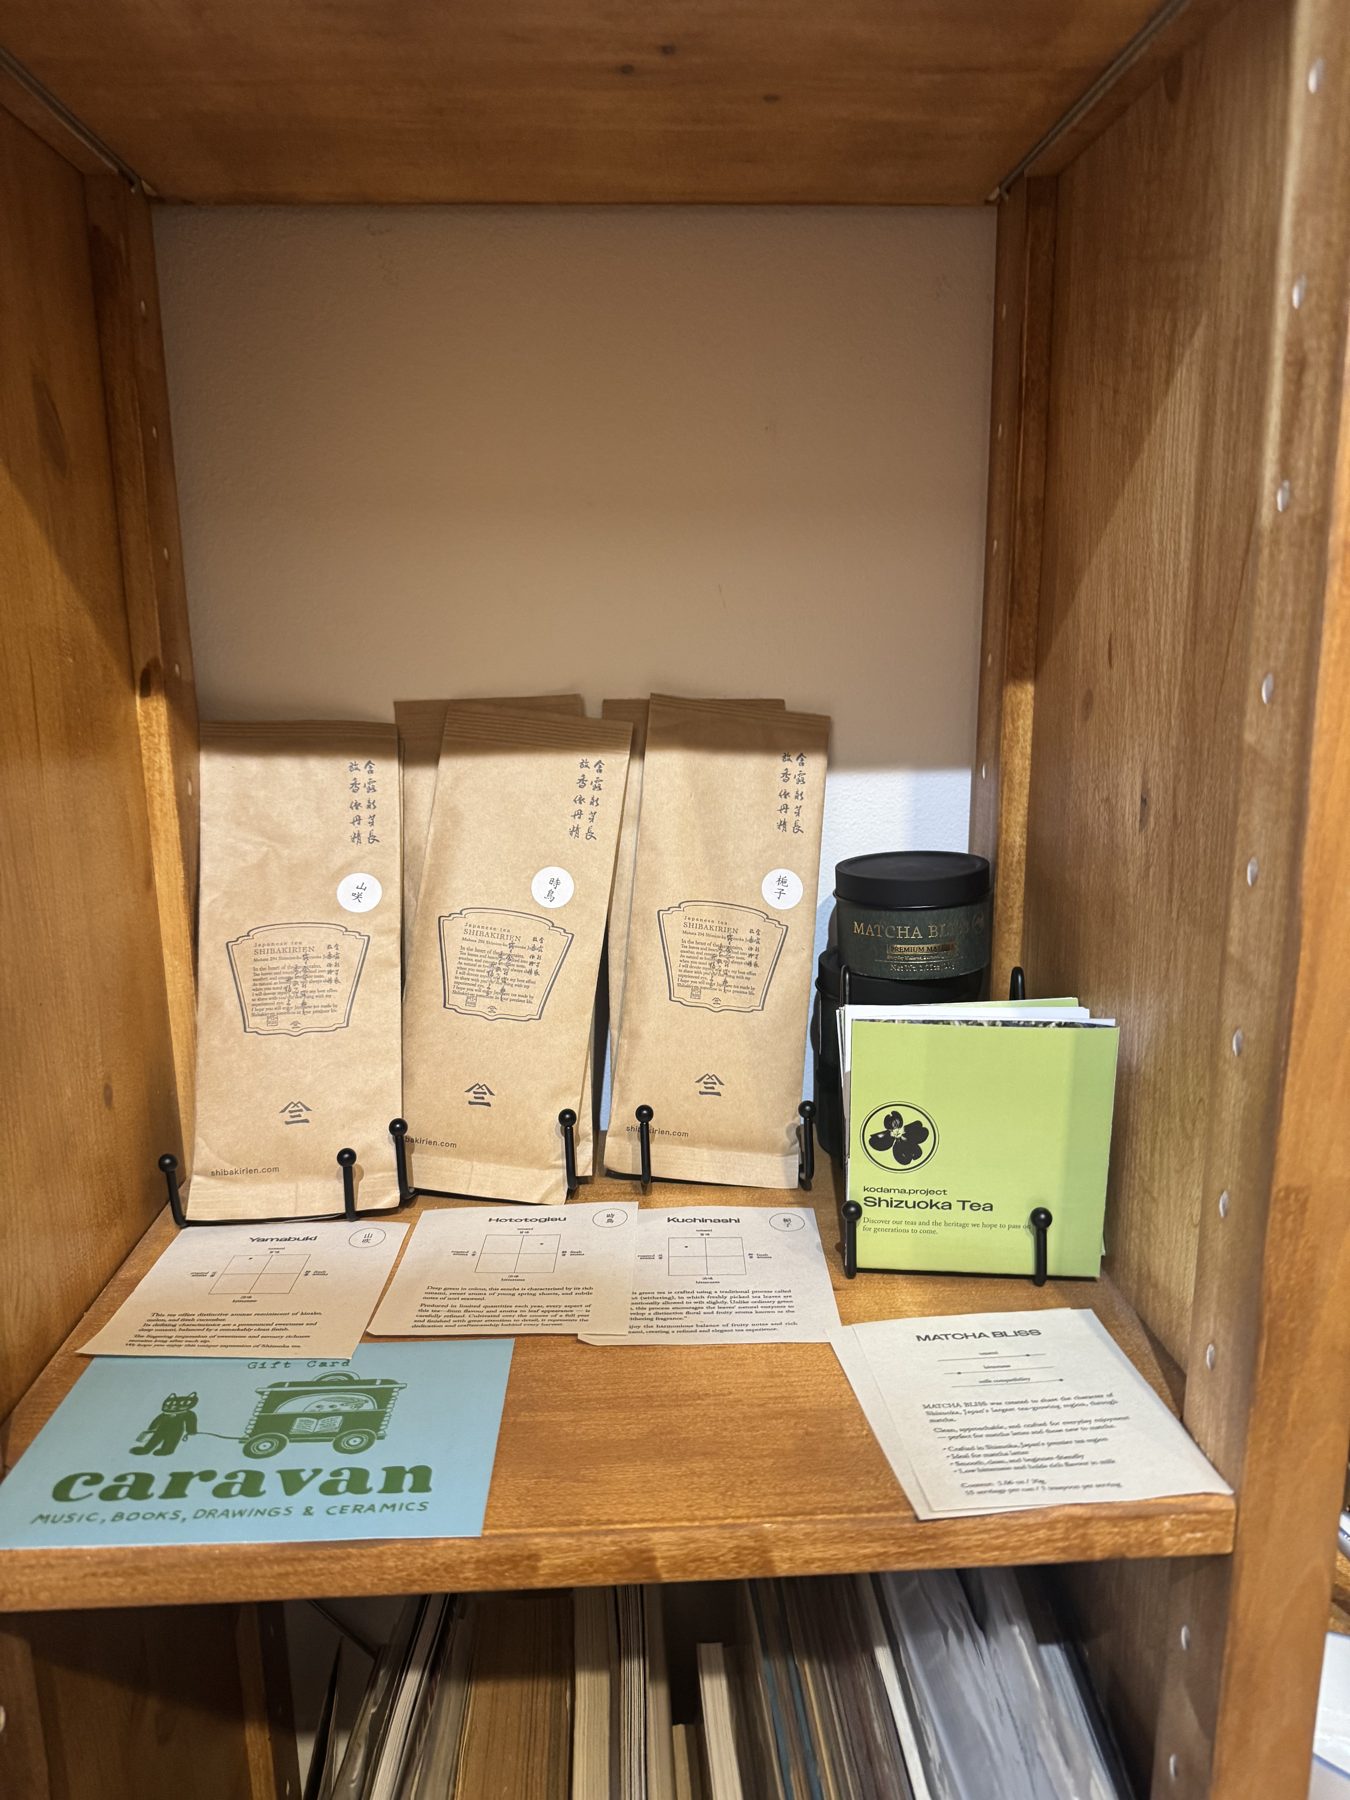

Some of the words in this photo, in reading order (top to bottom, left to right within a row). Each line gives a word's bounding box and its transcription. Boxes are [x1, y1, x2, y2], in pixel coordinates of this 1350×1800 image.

[683, 921, 739, 934] SHIBAKIRIEN
[853, 920, 923, 939] MATCHA
[463, 928, 521, 942] SHIBAKIRIEN
[253, 946, 315, 956] SHIBAKIRIEN
[626, 1125, 689, 1137] shiirien.com
[405, 1135, 457, 1148] bakirien.com
[210, 1166, 280, 1177] shibakirien.com
[863, 1185, 948, 1196] kodama.project
[863, 1196, 952, 1210] Shizuoka
[957, 1199, 993, 1212] Tea
[862, 1225, 873, 1233] for
[873, 1226, 910, 1235] generations
[863, 1217, 891, 1225] Discover
[931, 1219, 942, 1227] the
[943, 1220, 970, 1230] heritage
[982, 1221, 998, 1230] hope
[916, 1331, 990, 1342] MATCHA
[991, 1329, 1042, 1339] BLISS
[247, 1361, 291, 1369] Gift
[306, 1360, 350, 1368] Card
[51, 1464, 434, 1503] caravan
[192, 1505, 293, 1520] DRAWINGS
[302, 1505, 314, 1517] &
[326, 1501, 430, 1516] CERAMICS
